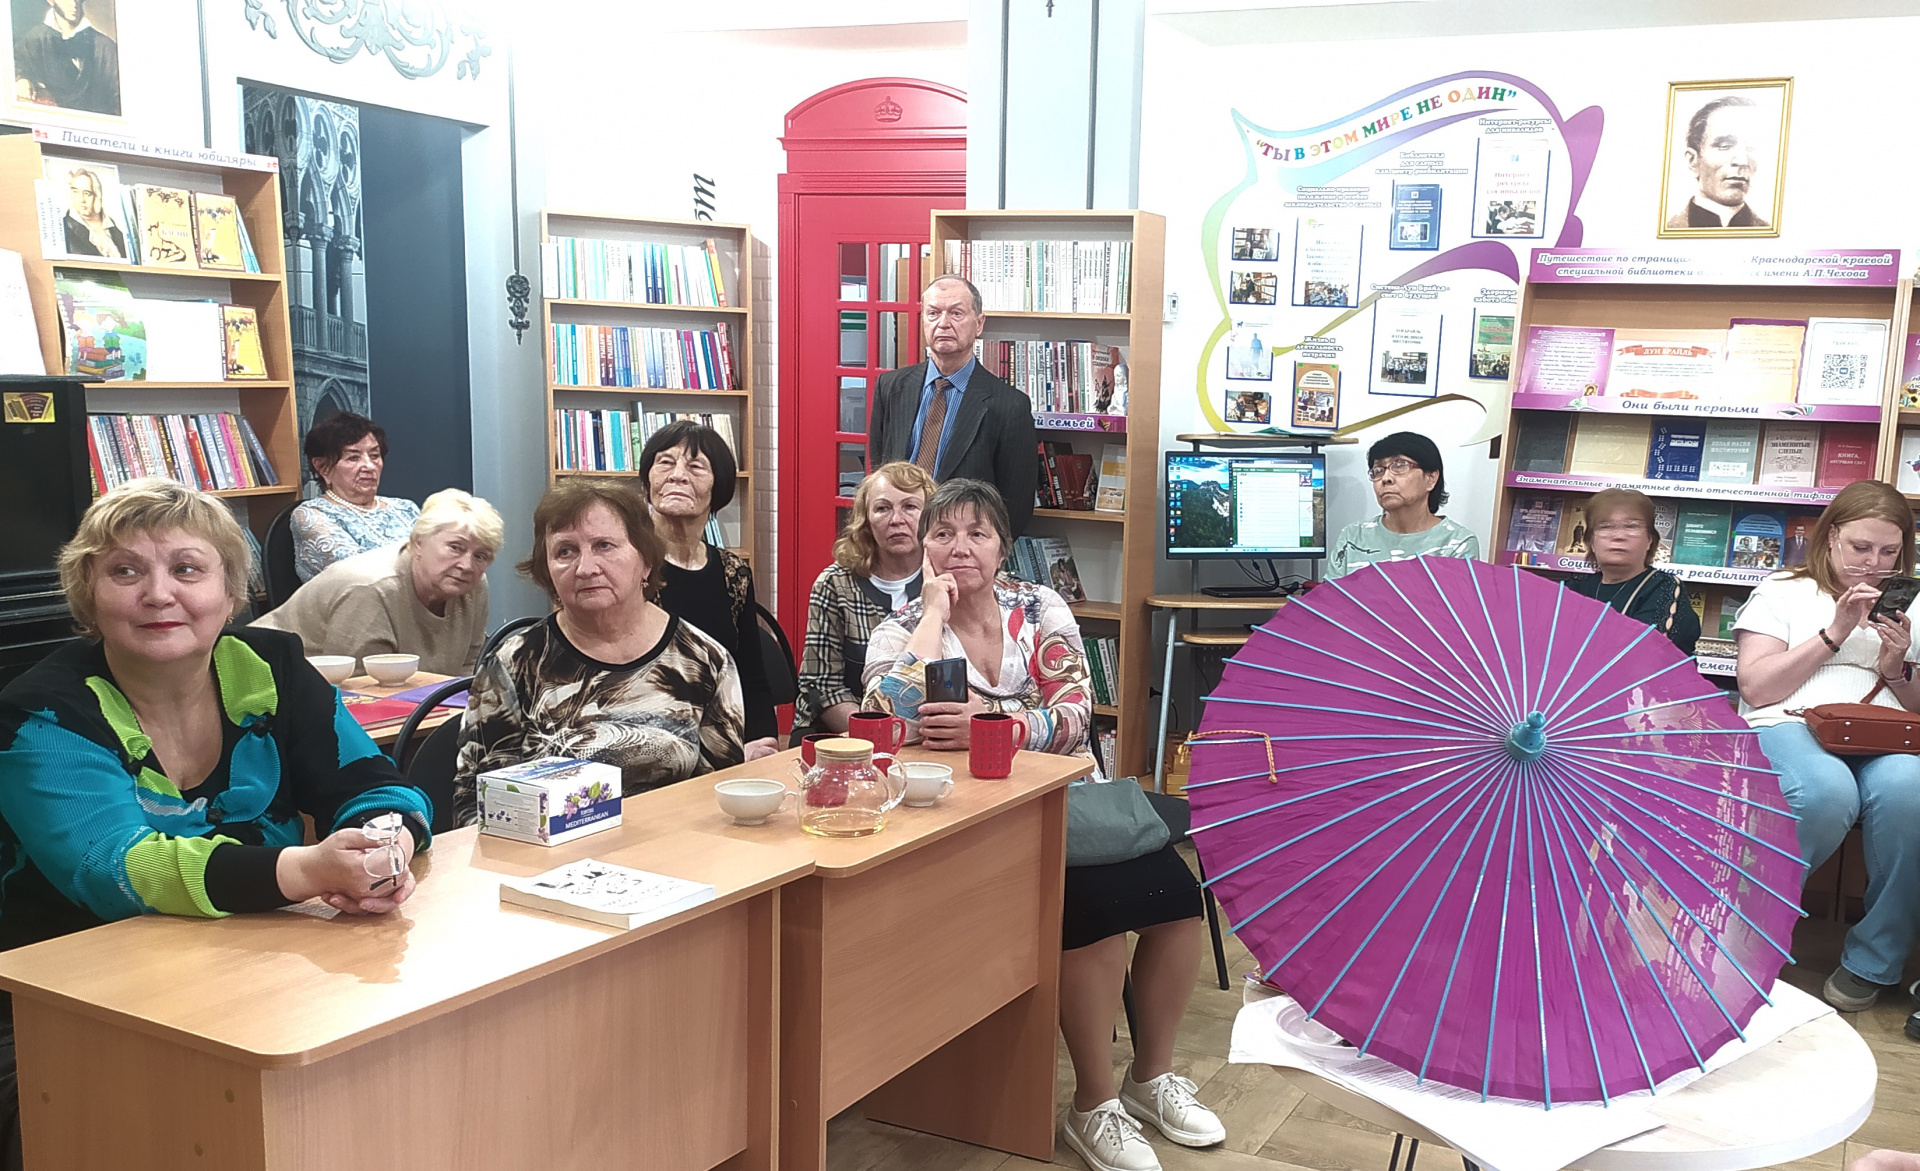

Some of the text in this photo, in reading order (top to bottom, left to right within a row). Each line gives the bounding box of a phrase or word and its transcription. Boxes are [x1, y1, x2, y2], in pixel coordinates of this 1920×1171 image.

[1294, 148, 1305, 160] В
[1310, 130, 1358, 156] ЭТОМ
[1362, 106, 1412, 138] МИРЕ
[1416, 96, 1442, 114] НЕ
[62, 131, 136, 151] Писатели
[154, 146, 193, 158] книги
[198, 151, 256, 168] юбиляры
[1539, 254, 1613, 264] Путешествие
[1751, 255, 1838, 265] Краснодарской
[1842, 255, 1891, 265] краевой
[1557, 268, 1623, 276] специальной
[1628, 268, 1693, 276] библиотеки
[1622, 400, 1759, 414] Они были первыми
[1048, 418, 1093, 428] семьей
[1516, 475, 1602, 488] Знаменательные
[1615, 483, 1670, 492] памятные
[1674, 485, 1702, 493] даты
[1706, 488, 1790, 498] отечественной
[565, 811, 609, 829] MEDITERRANEAN
